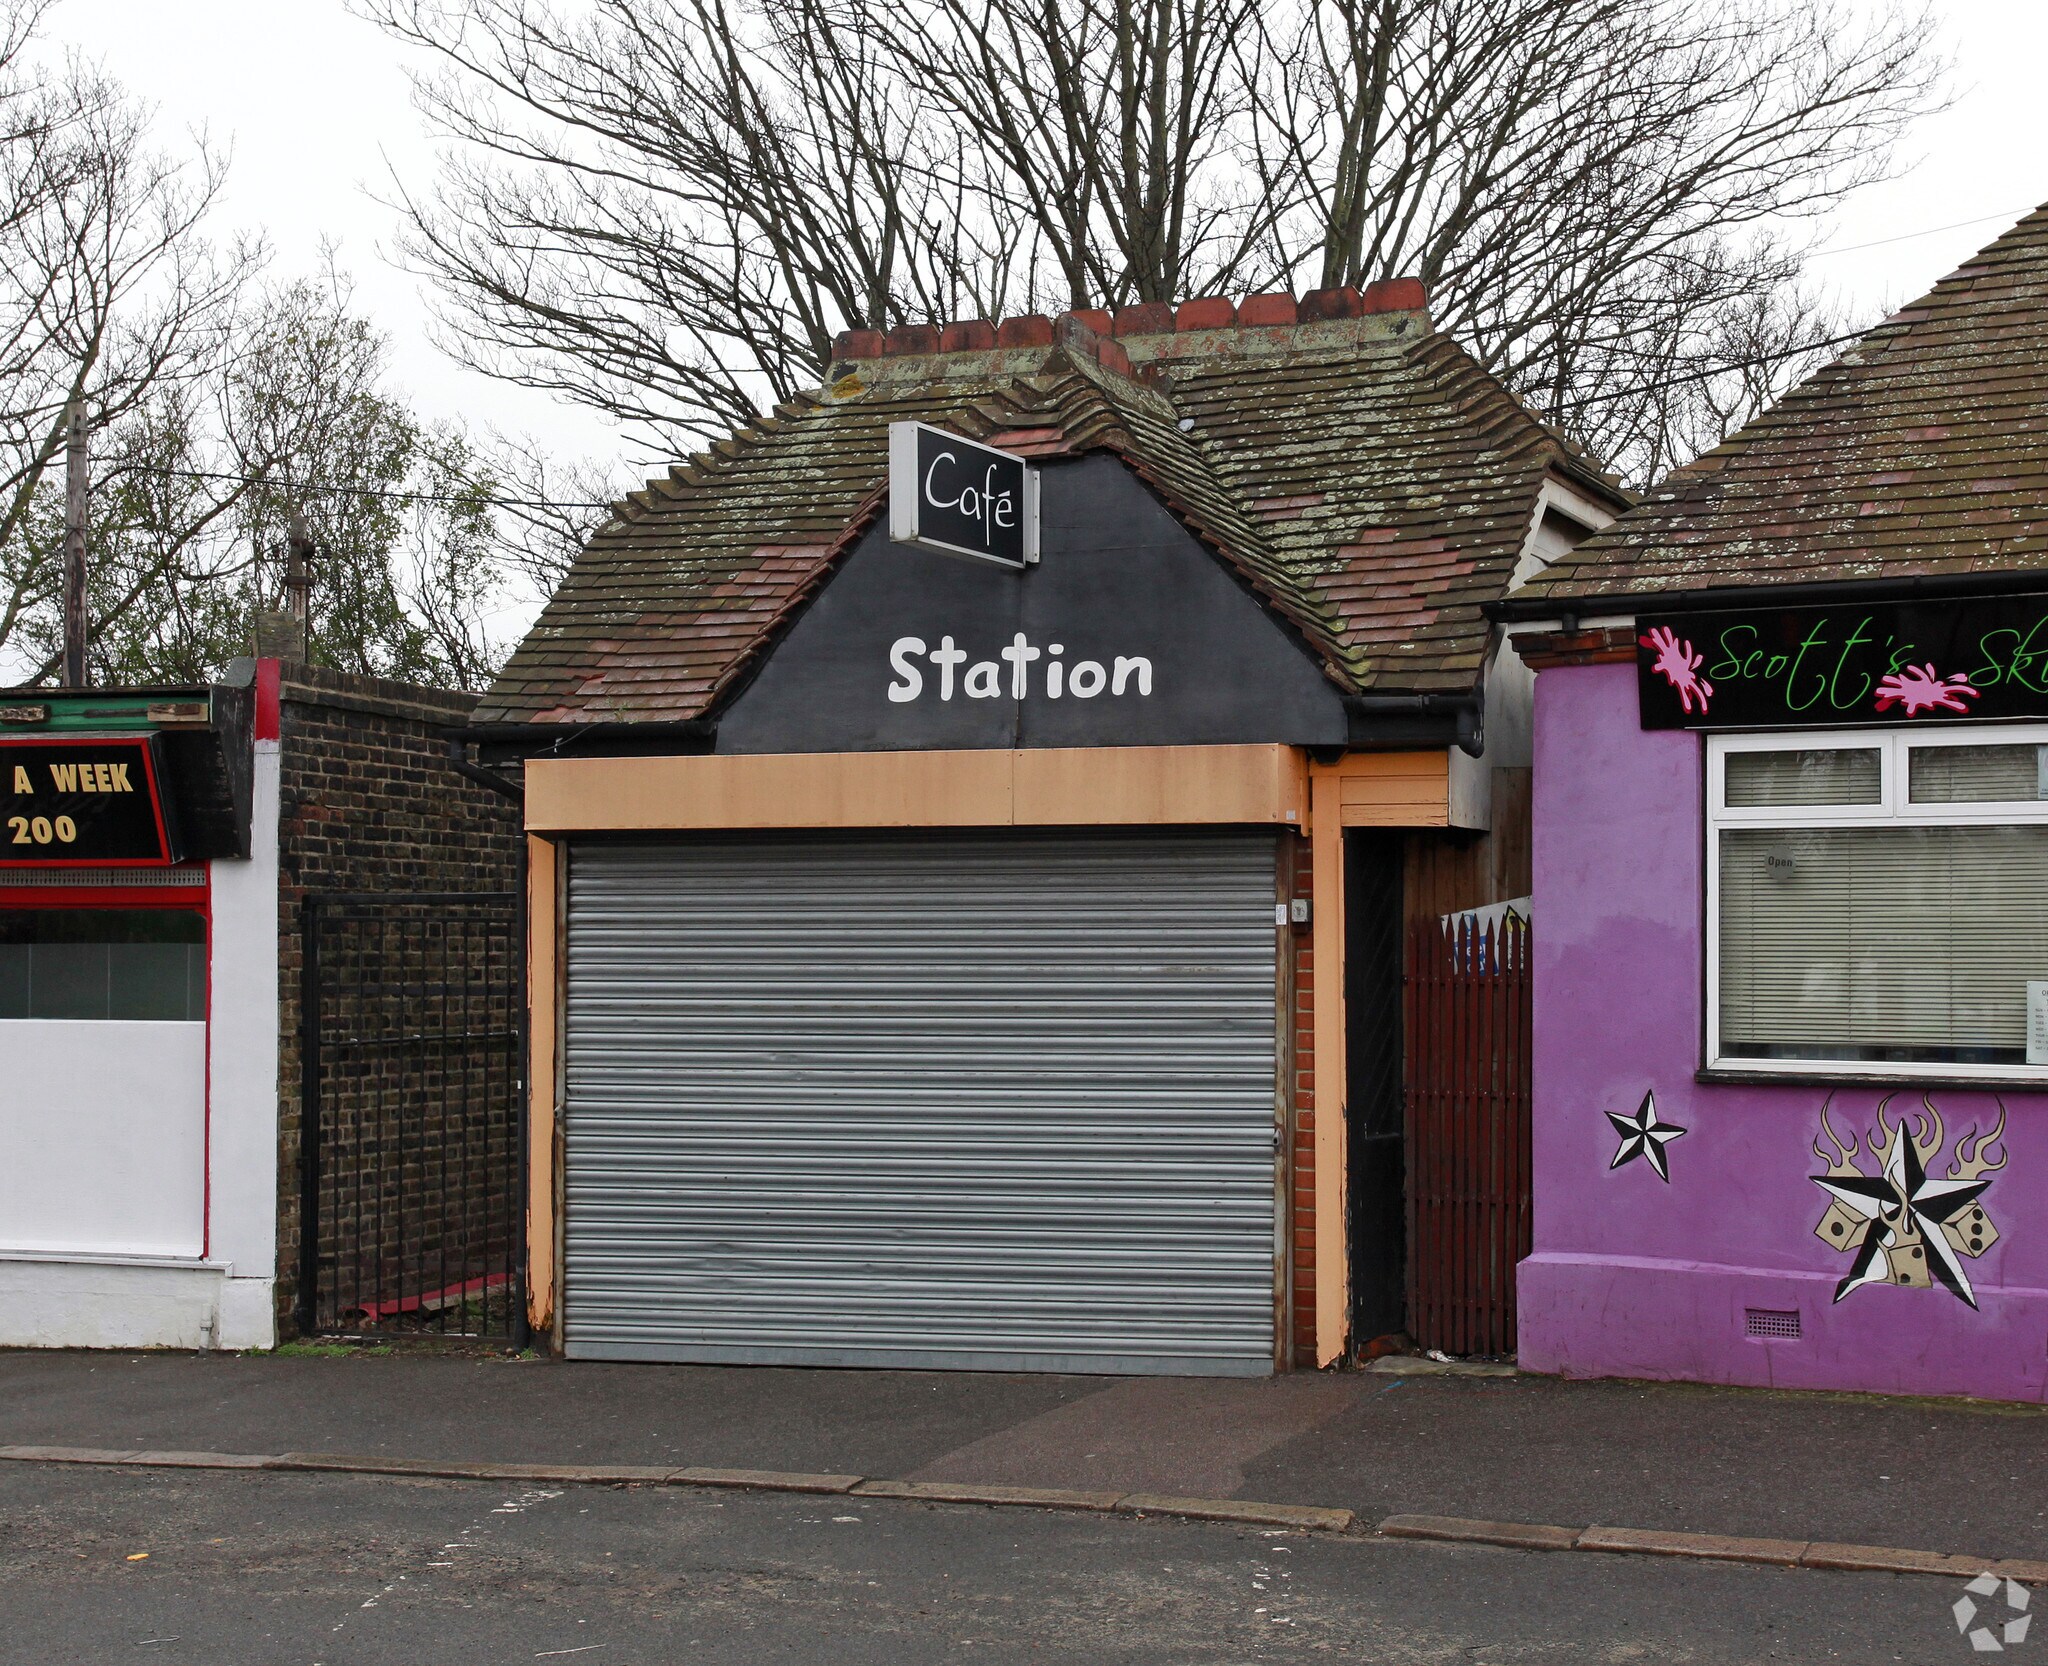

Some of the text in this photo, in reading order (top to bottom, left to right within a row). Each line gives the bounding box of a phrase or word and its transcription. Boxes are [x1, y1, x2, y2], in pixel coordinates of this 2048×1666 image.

[925, 452, 1015, 546] Café
[887, 632, 1153, 702] Station
[1709, 616, 1915, 711] Scott's
[13, 763, 134, 794] A WEEK
[8, 815, 77, 844] 200
[1768, 855, 1793, 868] Open
